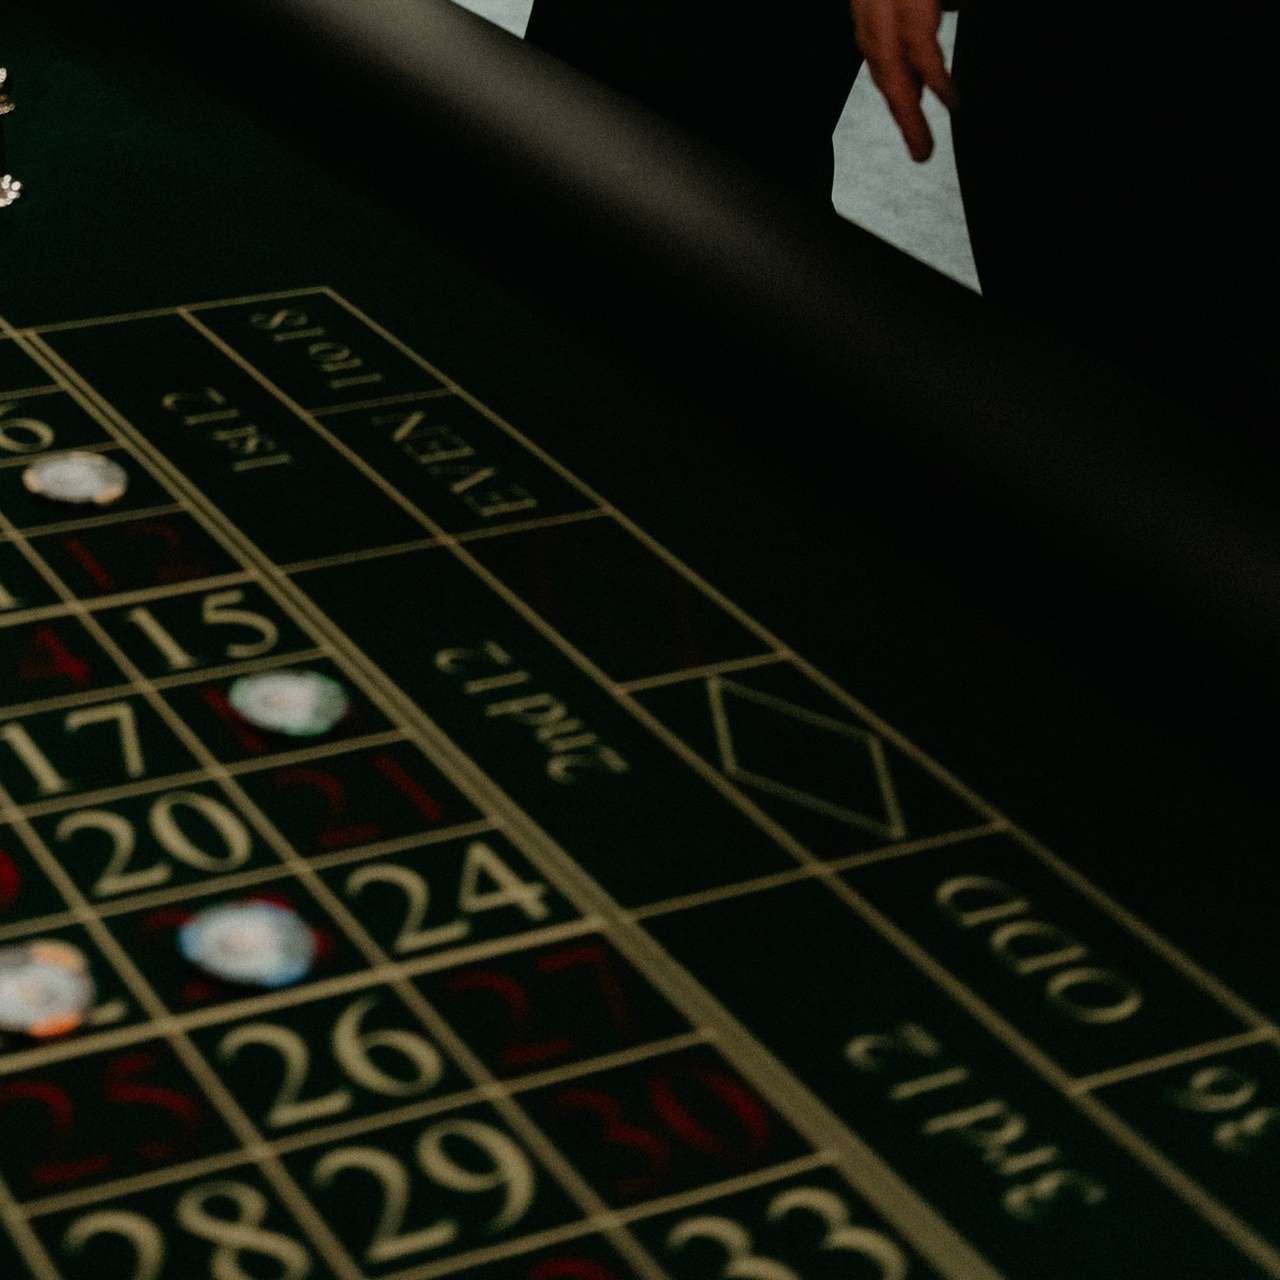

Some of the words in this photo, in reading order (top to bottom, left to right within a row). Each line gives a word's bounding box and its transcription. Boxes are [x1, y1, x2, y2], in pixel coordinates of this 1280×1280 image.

[370, 409, 538, 518] EVEN
[65, 523, 212, 591] 12
[126, 589, 279, 671] 15
[54, 792, 254, 896] 20
[273, 756, 445, 848] 21
[345, 840, 554, 955] 24
[934, 874, 1143, 1024] ODD
[445, 945, 637, 1065] 27
[216, 996, 445, 1130] 26
[552, 1061, 773, 1196] 30
[63, 1181, 314, 1280] 28
[312, 1116, 538, 1264] 29
